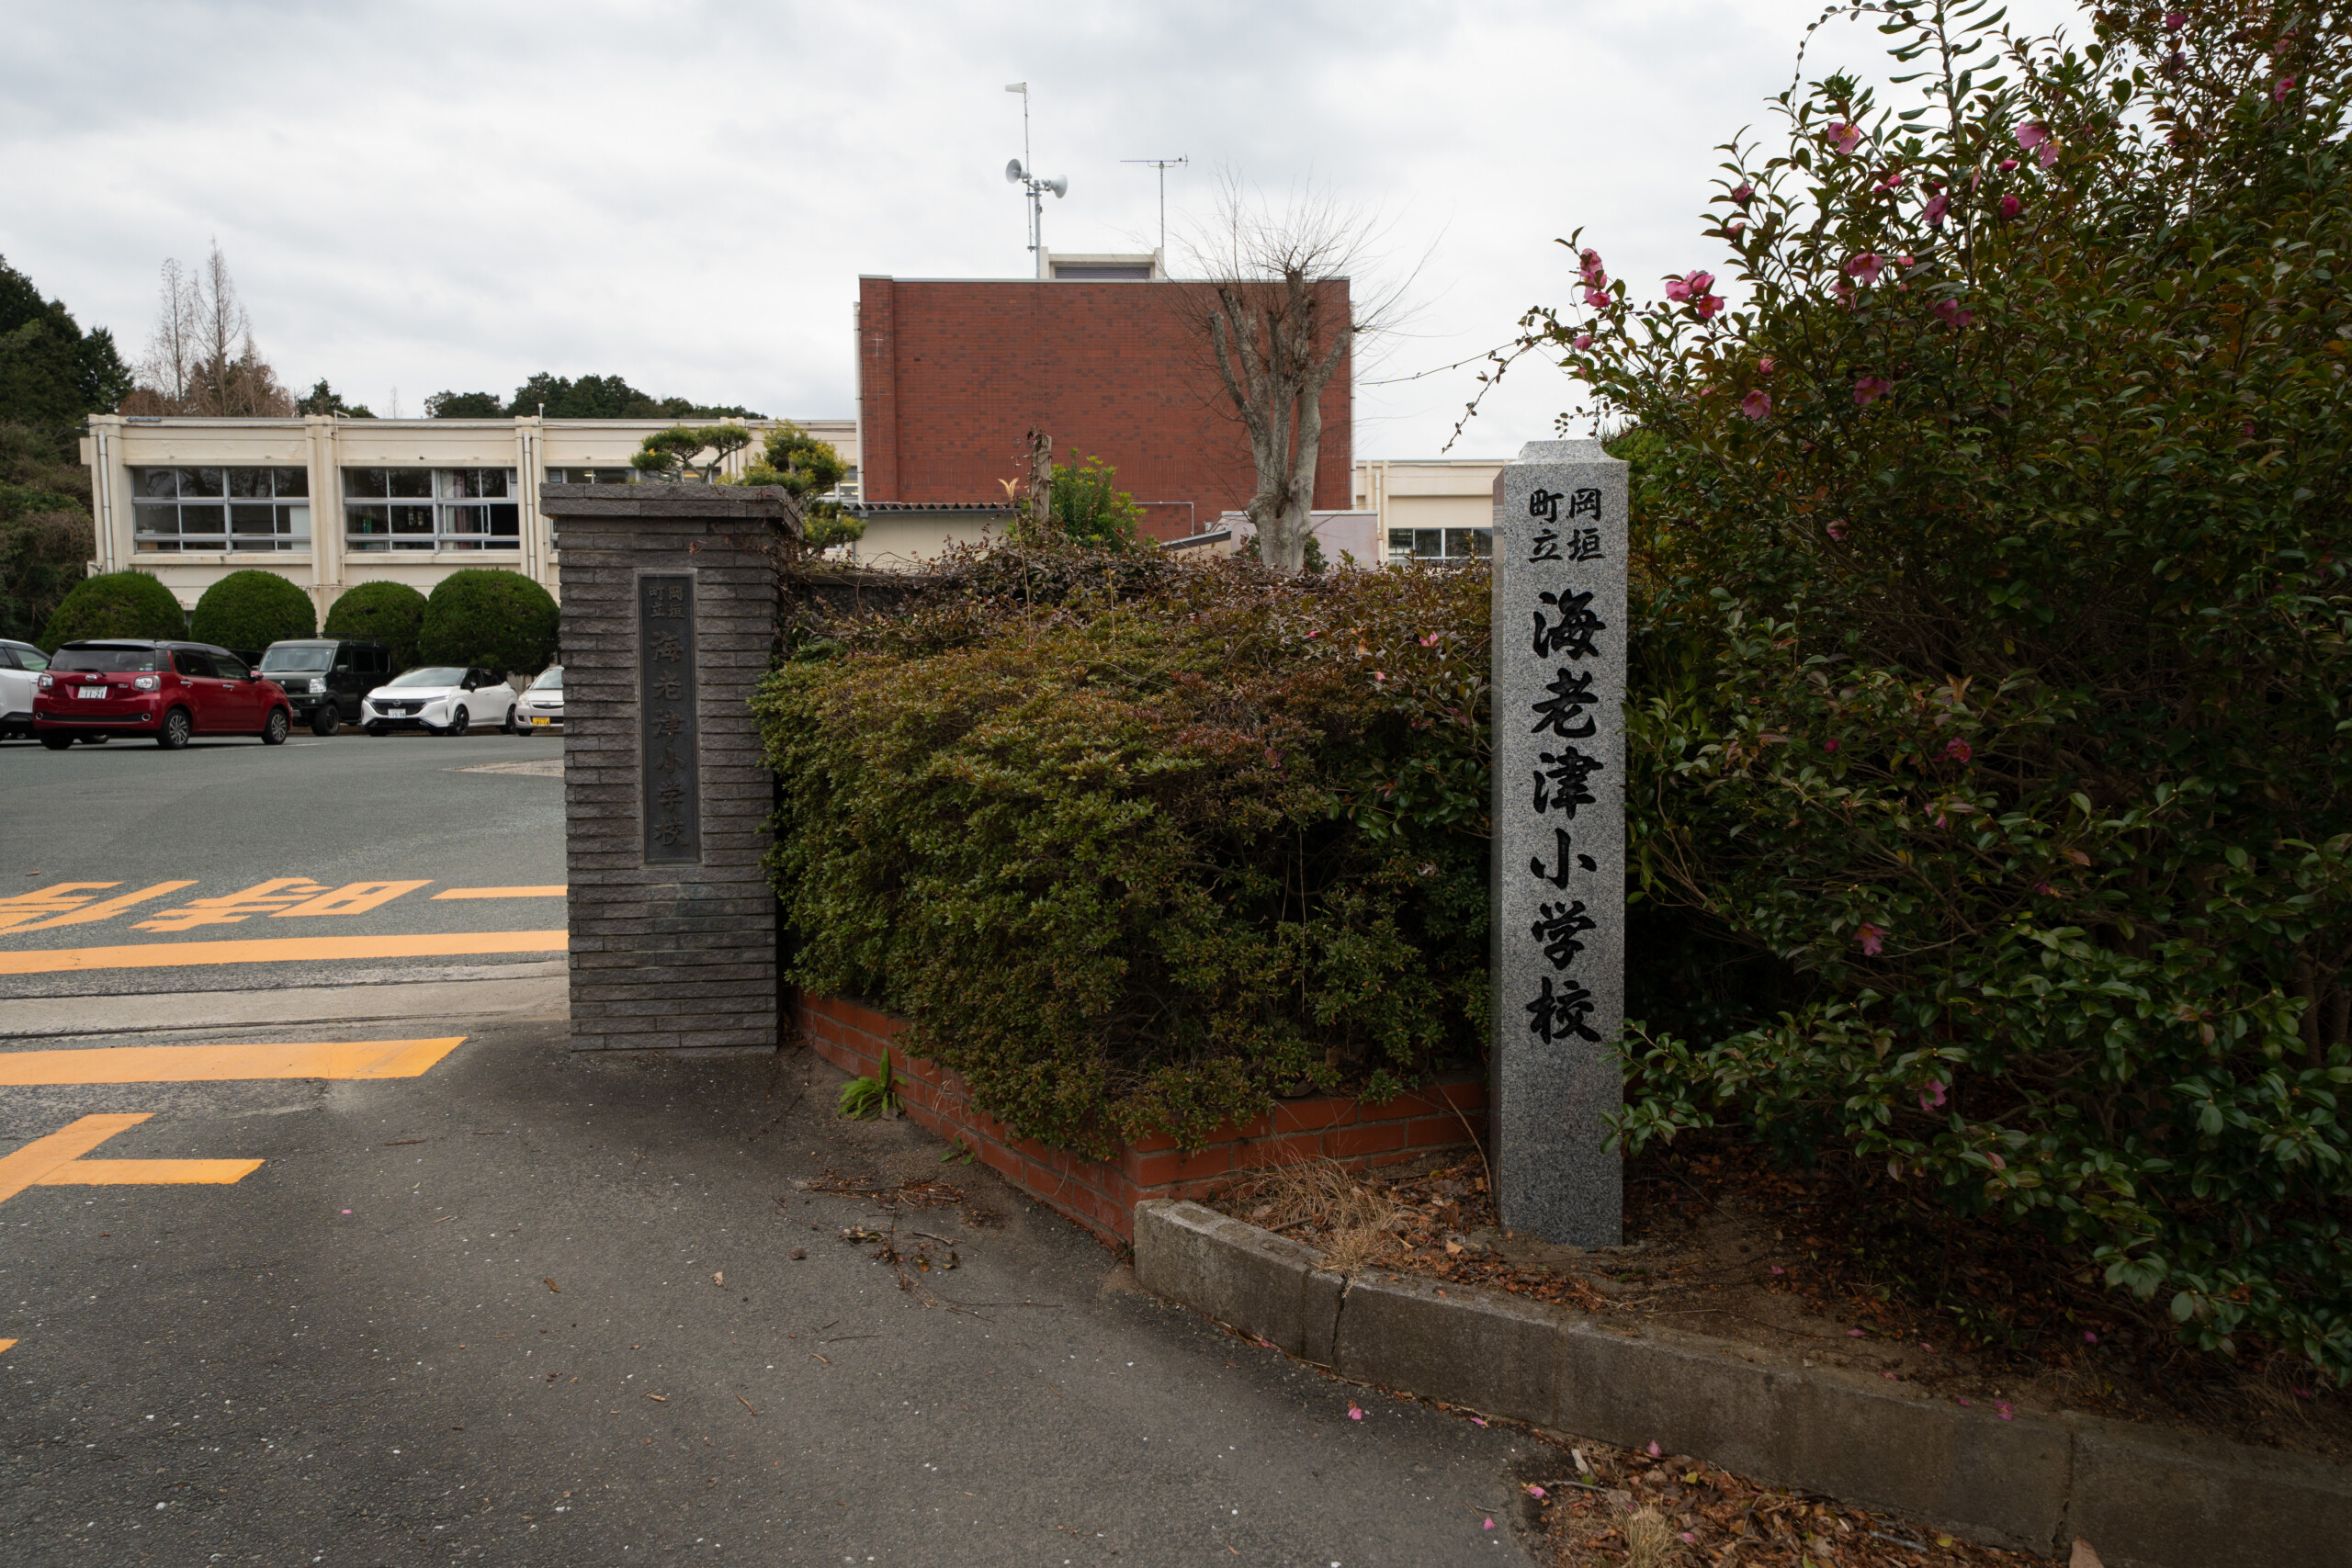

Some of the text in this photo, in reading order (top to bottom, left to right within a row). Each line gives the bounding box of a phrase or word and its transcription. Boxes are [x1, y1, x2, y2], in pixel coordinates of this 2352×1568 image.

[1528, 489, 1564, 562] 町立
[1567, 488, 1606, 562] 岡垣
[648, 587, 665, 619] 町立
[668, 586, 685, 619] 岡垣
[650, 630, 690, 847] 海老津小学校
[1526, 588, 1607, 1045] 海老津小学校
